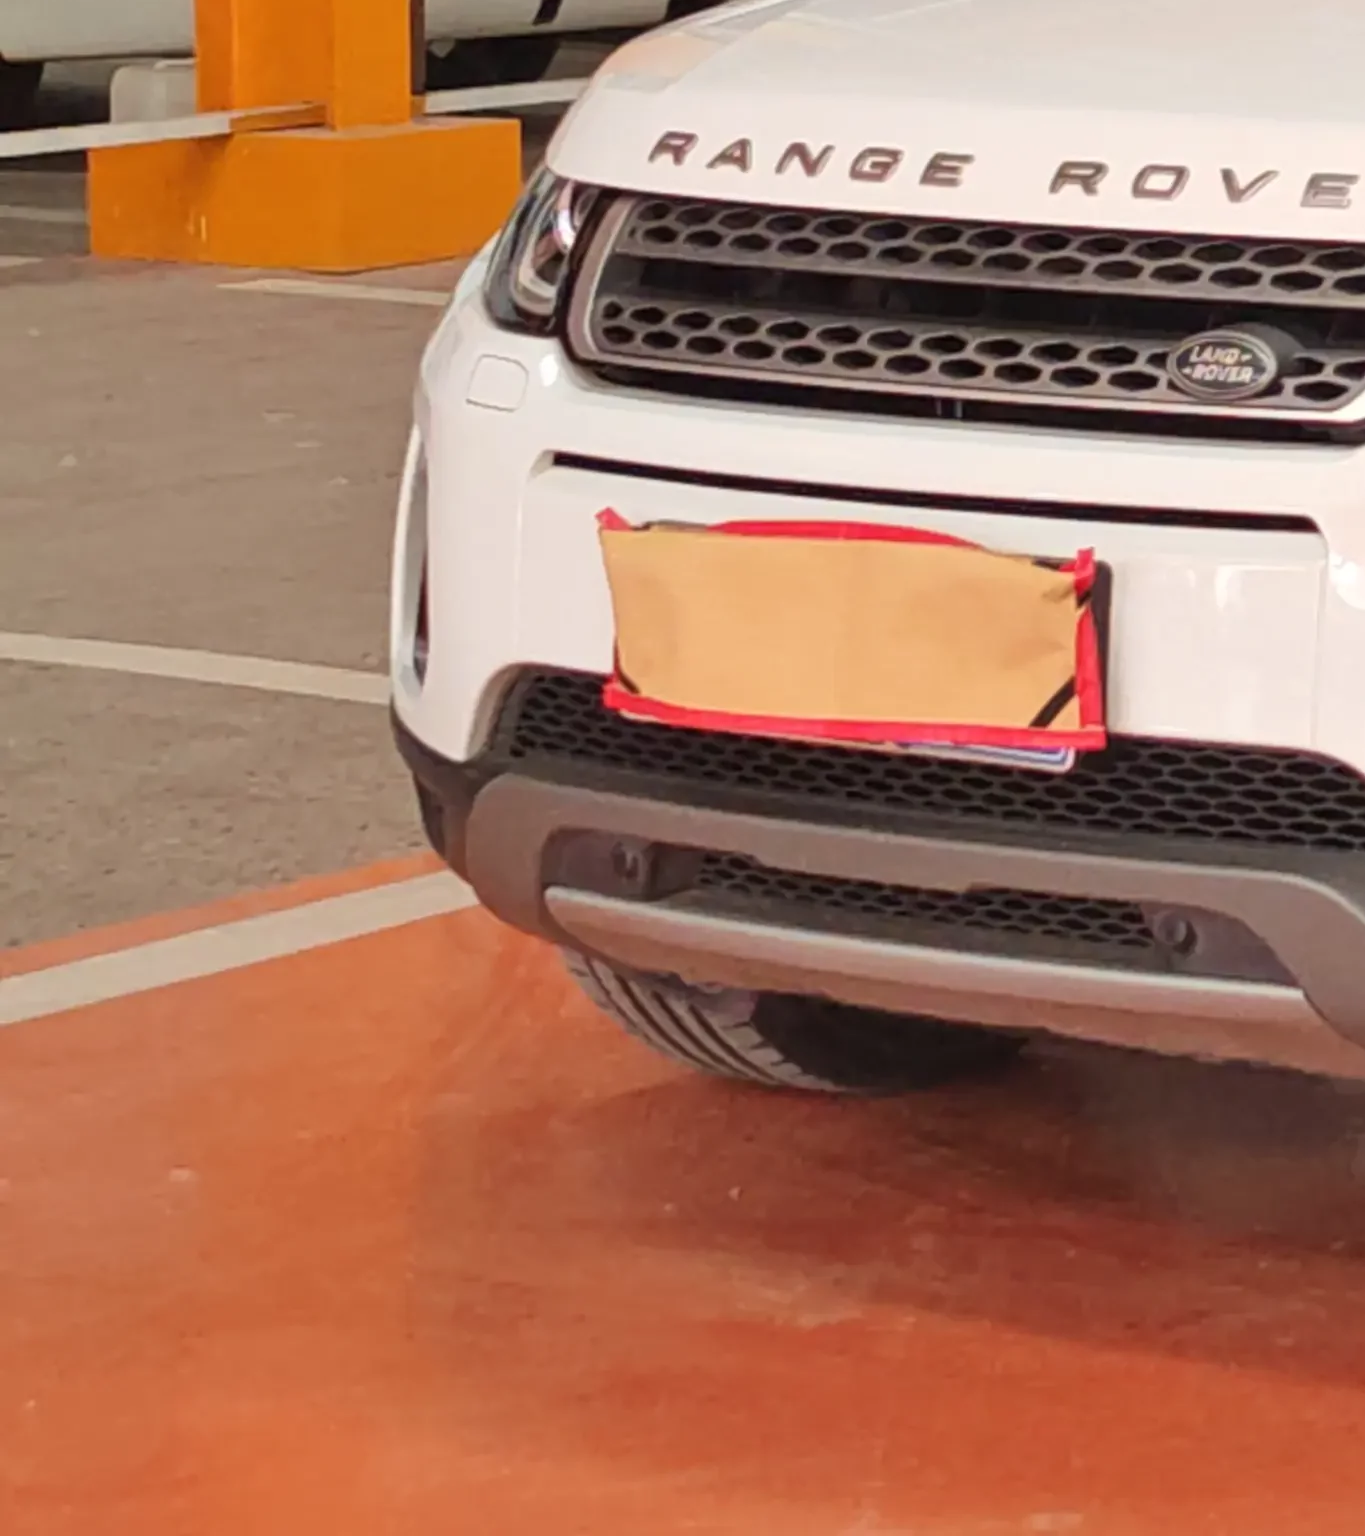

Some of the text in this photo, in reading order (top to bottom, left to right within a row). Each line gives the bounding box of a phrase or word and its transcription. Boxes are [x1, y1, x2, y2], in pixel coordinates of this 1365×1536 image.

[647, 130, 975, 189] RANGE
[1189, 345, 1242, 365] LAND
[1191, 363, 1254, 383] ROVER
